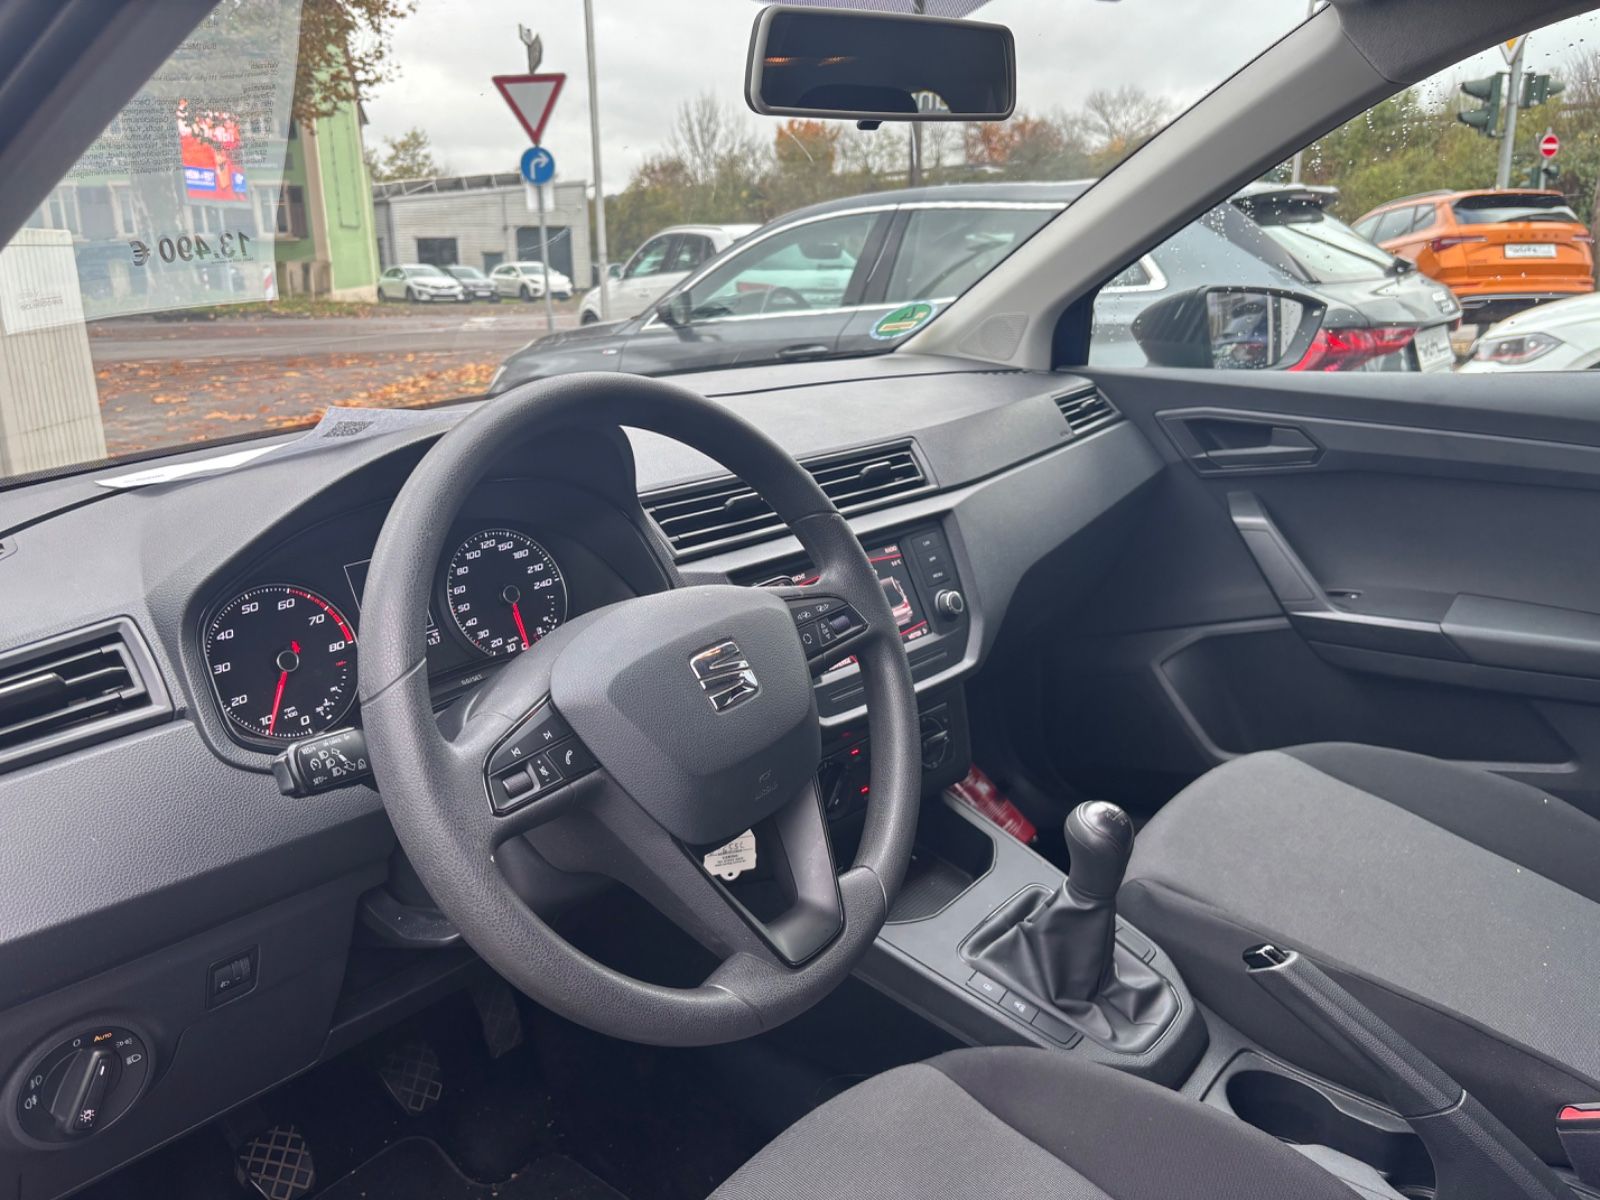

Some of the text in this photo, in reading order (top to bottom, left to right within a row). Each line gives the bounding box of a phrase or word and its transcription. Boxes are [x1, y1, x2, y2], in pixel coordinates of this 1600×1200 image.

[480, 538, 496, 550] 120
[497, 540, 514, 551] 150
[465, 549, 481, 560] 100
[512, 548, 529, 560] 180
[456, 566, 469, 576] 80
[527, 562, 544, 574] 210
[533, 578, 553, 590] 240
[453, 585, 466, 596] 60
[241, 601, 259, 615] 50
[277, 597, 296, 611] 60
[457, 602, 470, 614] 50
[308, 613, 325, 626] 70
[465, 617, 478, 627] 40
[216, 629, 234, 641] 40
[476, 628, 490, 640] 30
[328, 640, 345, 653] 80
[490, 637, 503, 648] 20
[505, 642, 517, 653] 10
[213, 661, 231, 675] 30
[231, 694, 248, 708] 20
[259, 714, 272, 726] 10
[300, 715, 310, 726] 0
